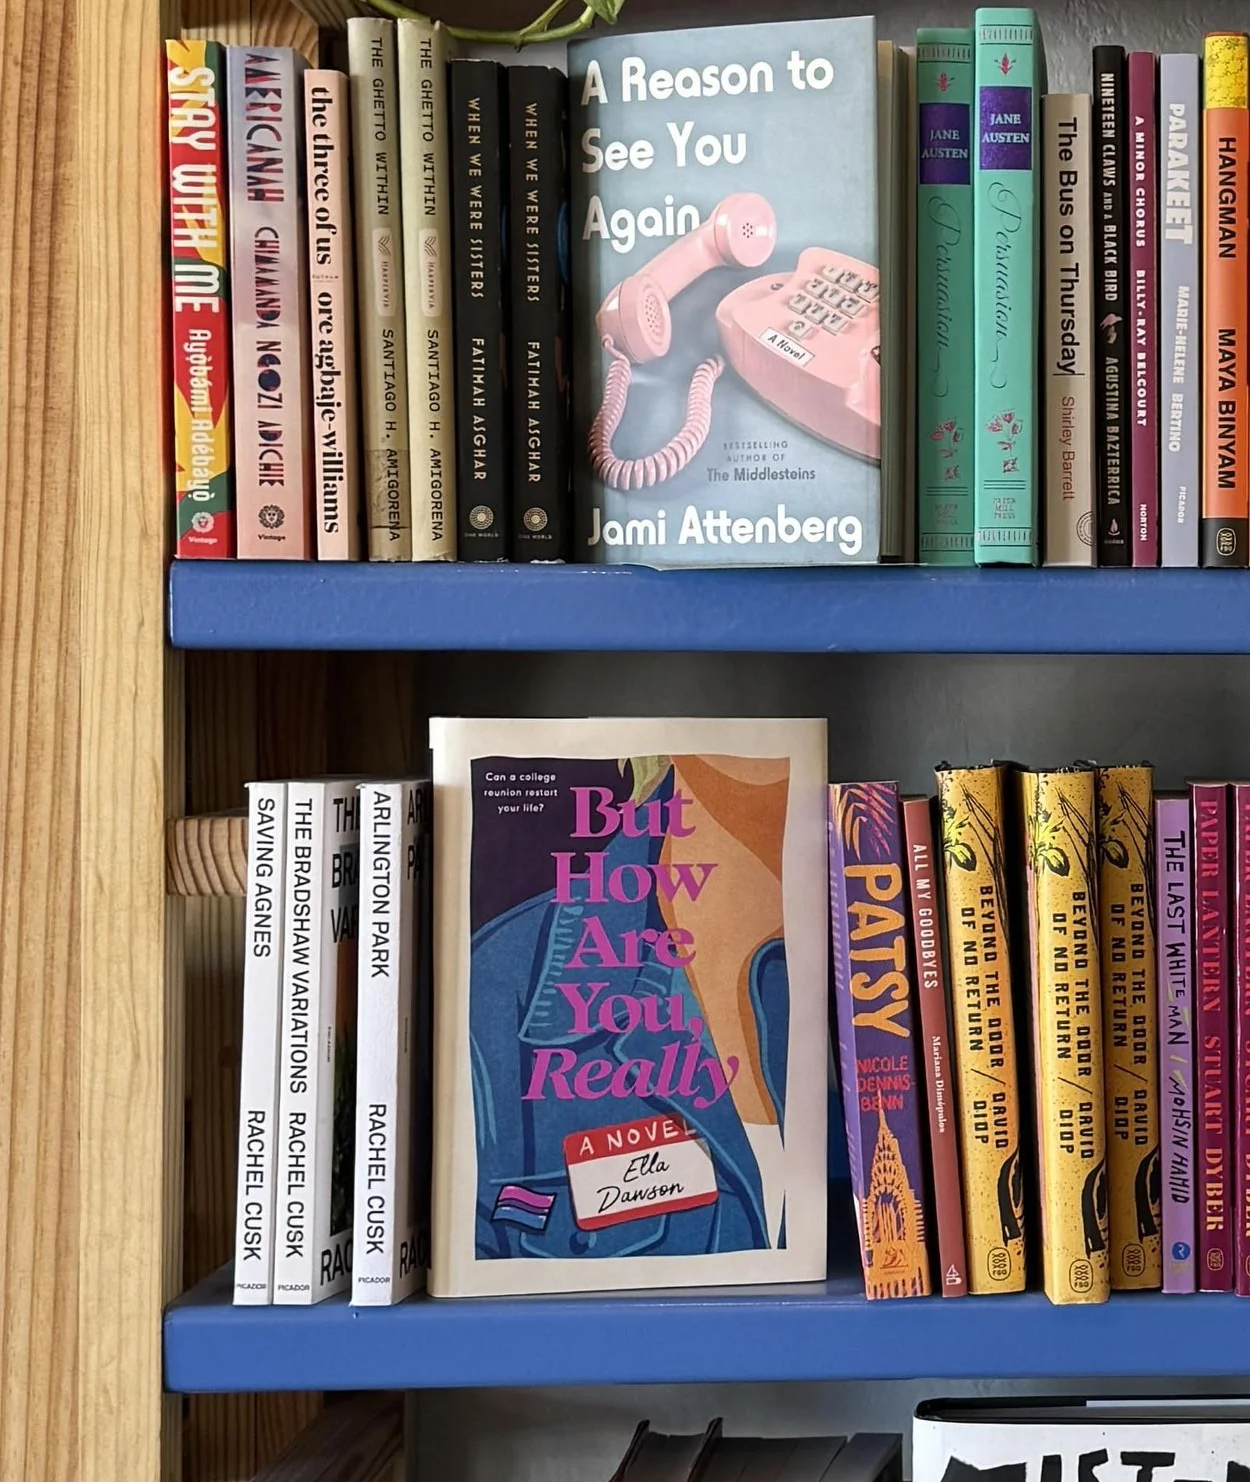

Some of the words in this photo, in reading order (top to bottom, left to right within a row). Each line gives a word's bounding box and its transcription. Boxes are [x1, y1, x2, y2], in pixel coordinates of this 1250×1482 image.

[583, 60, 608, 105] A
[621, 56, 776, 101] Reason
[786, 51, 835, 91] to
[167, 66, 216, 152] STAY
[990, 113, 1021, 125] JANE
[583, 130, 654, 173] See
[667, 122, 747, 167] You
[981, 132, 1030, 144] AUSTEN
[170, 163, 218, 248] WITH
[1218, 136, 1237, 260] HANGMAN
[583, 200, 701, 254] Again
[172, 264, 219, 314] ME
[1218, 328, 1236, 396] MAYA
[1217, 404, 1236, 490] BINYAM
[588, 512, 672, 555] Jami
[682, 510, 863, 556] Attenberg
[484, 788, 522, 797] reunion
[525, 788, 558, 797] restart
[485, 772, 506, 781] Can
[519, 772, 556, 784] college
[498, 805, 520, 814] your
[523, 803, 544, 813] life?
[569, 787, 696, 838] But
[550, 852, 718, 904] How
[563, 918, 697, 968] Are
[845, 864, 911, 1040] PATSY
[567, 982, 702, 1040] You,
[522, 1048, 739, 1108] Really
[579, 1135, 594, 1155] A
[623, 1155, 670, 1183] Ella
[597, 1181, 685, 1212] Dawson
